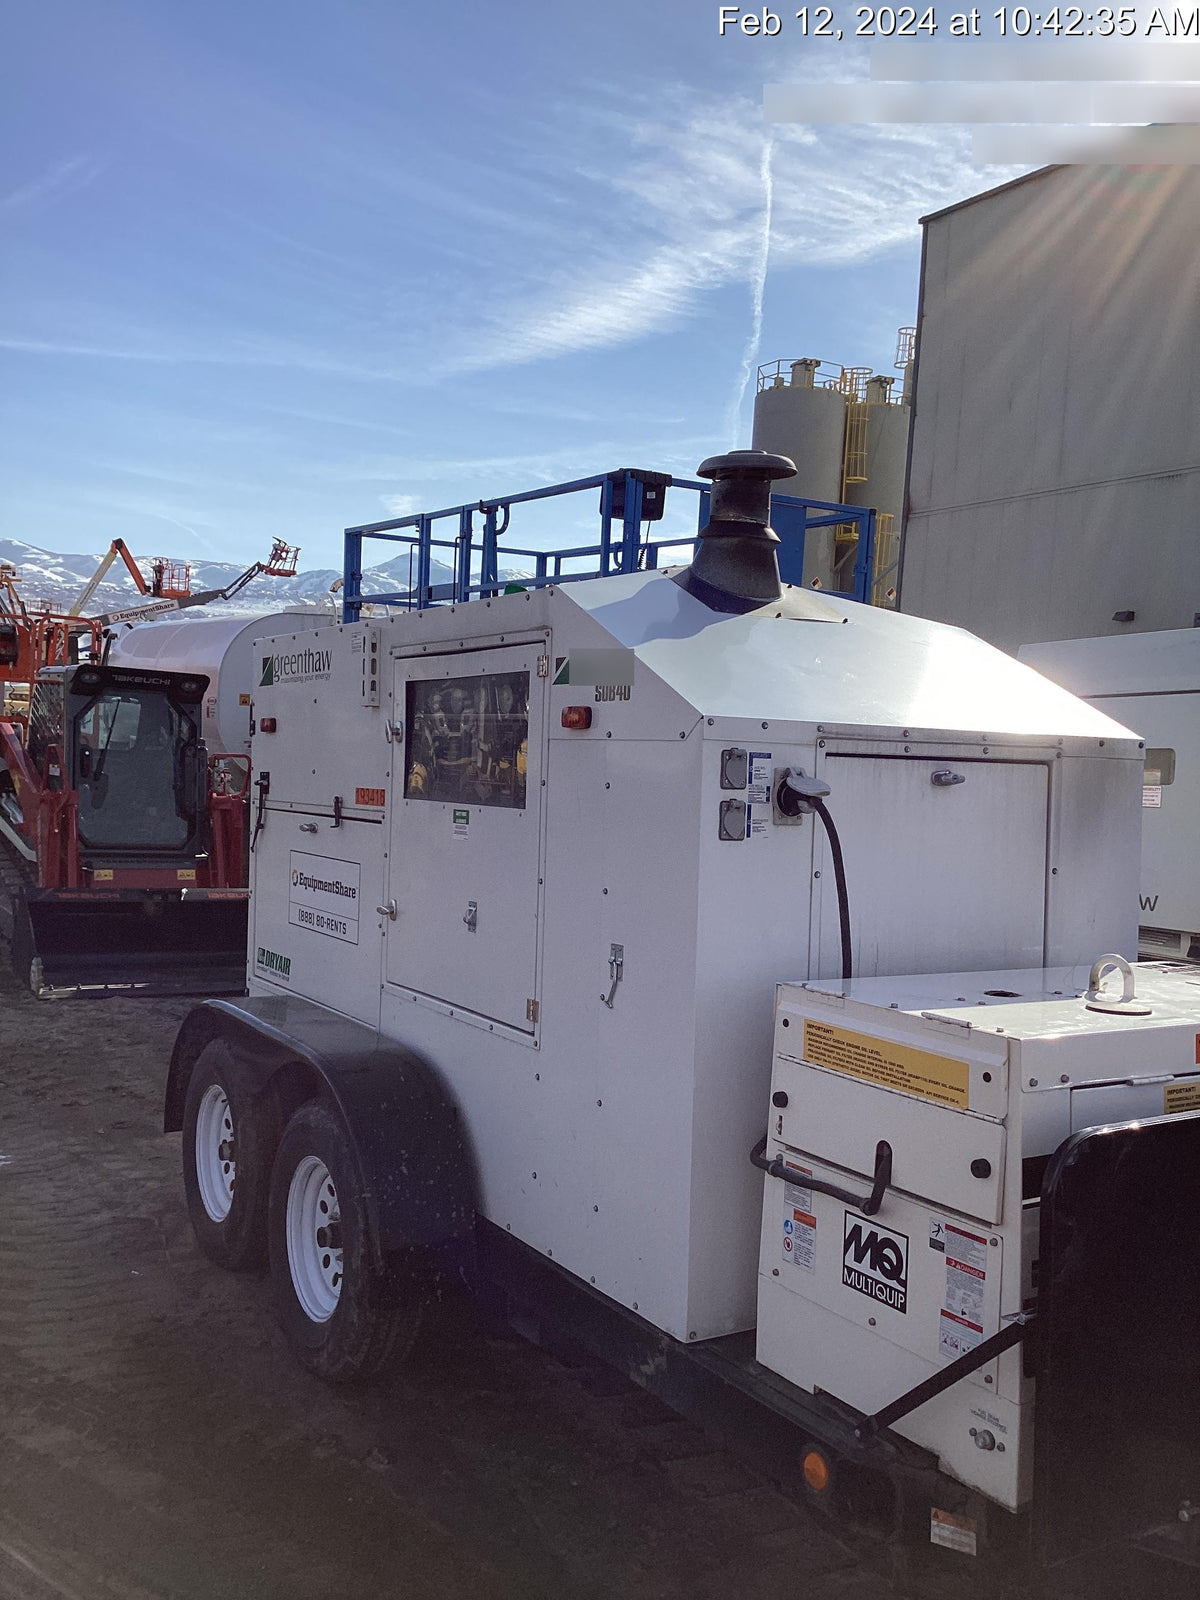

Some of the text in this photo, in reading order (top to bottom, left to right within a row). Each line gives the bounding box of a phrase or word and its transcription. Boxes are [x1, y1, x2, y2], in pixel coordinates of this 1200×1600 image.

[273, 648, 332, 682] greenthaw
[112, 675, 171, 686] TAKEUCHI
[299, 872, 356, 899] EquipmentShare
[298, 908, 347, 935] (888) 80-RENTS
[264, 949, 291, 976] DRYAIR
[845, 1223, 905, 1289] MQ
[844, 1267, 905, 1309] MULTIQUIP
